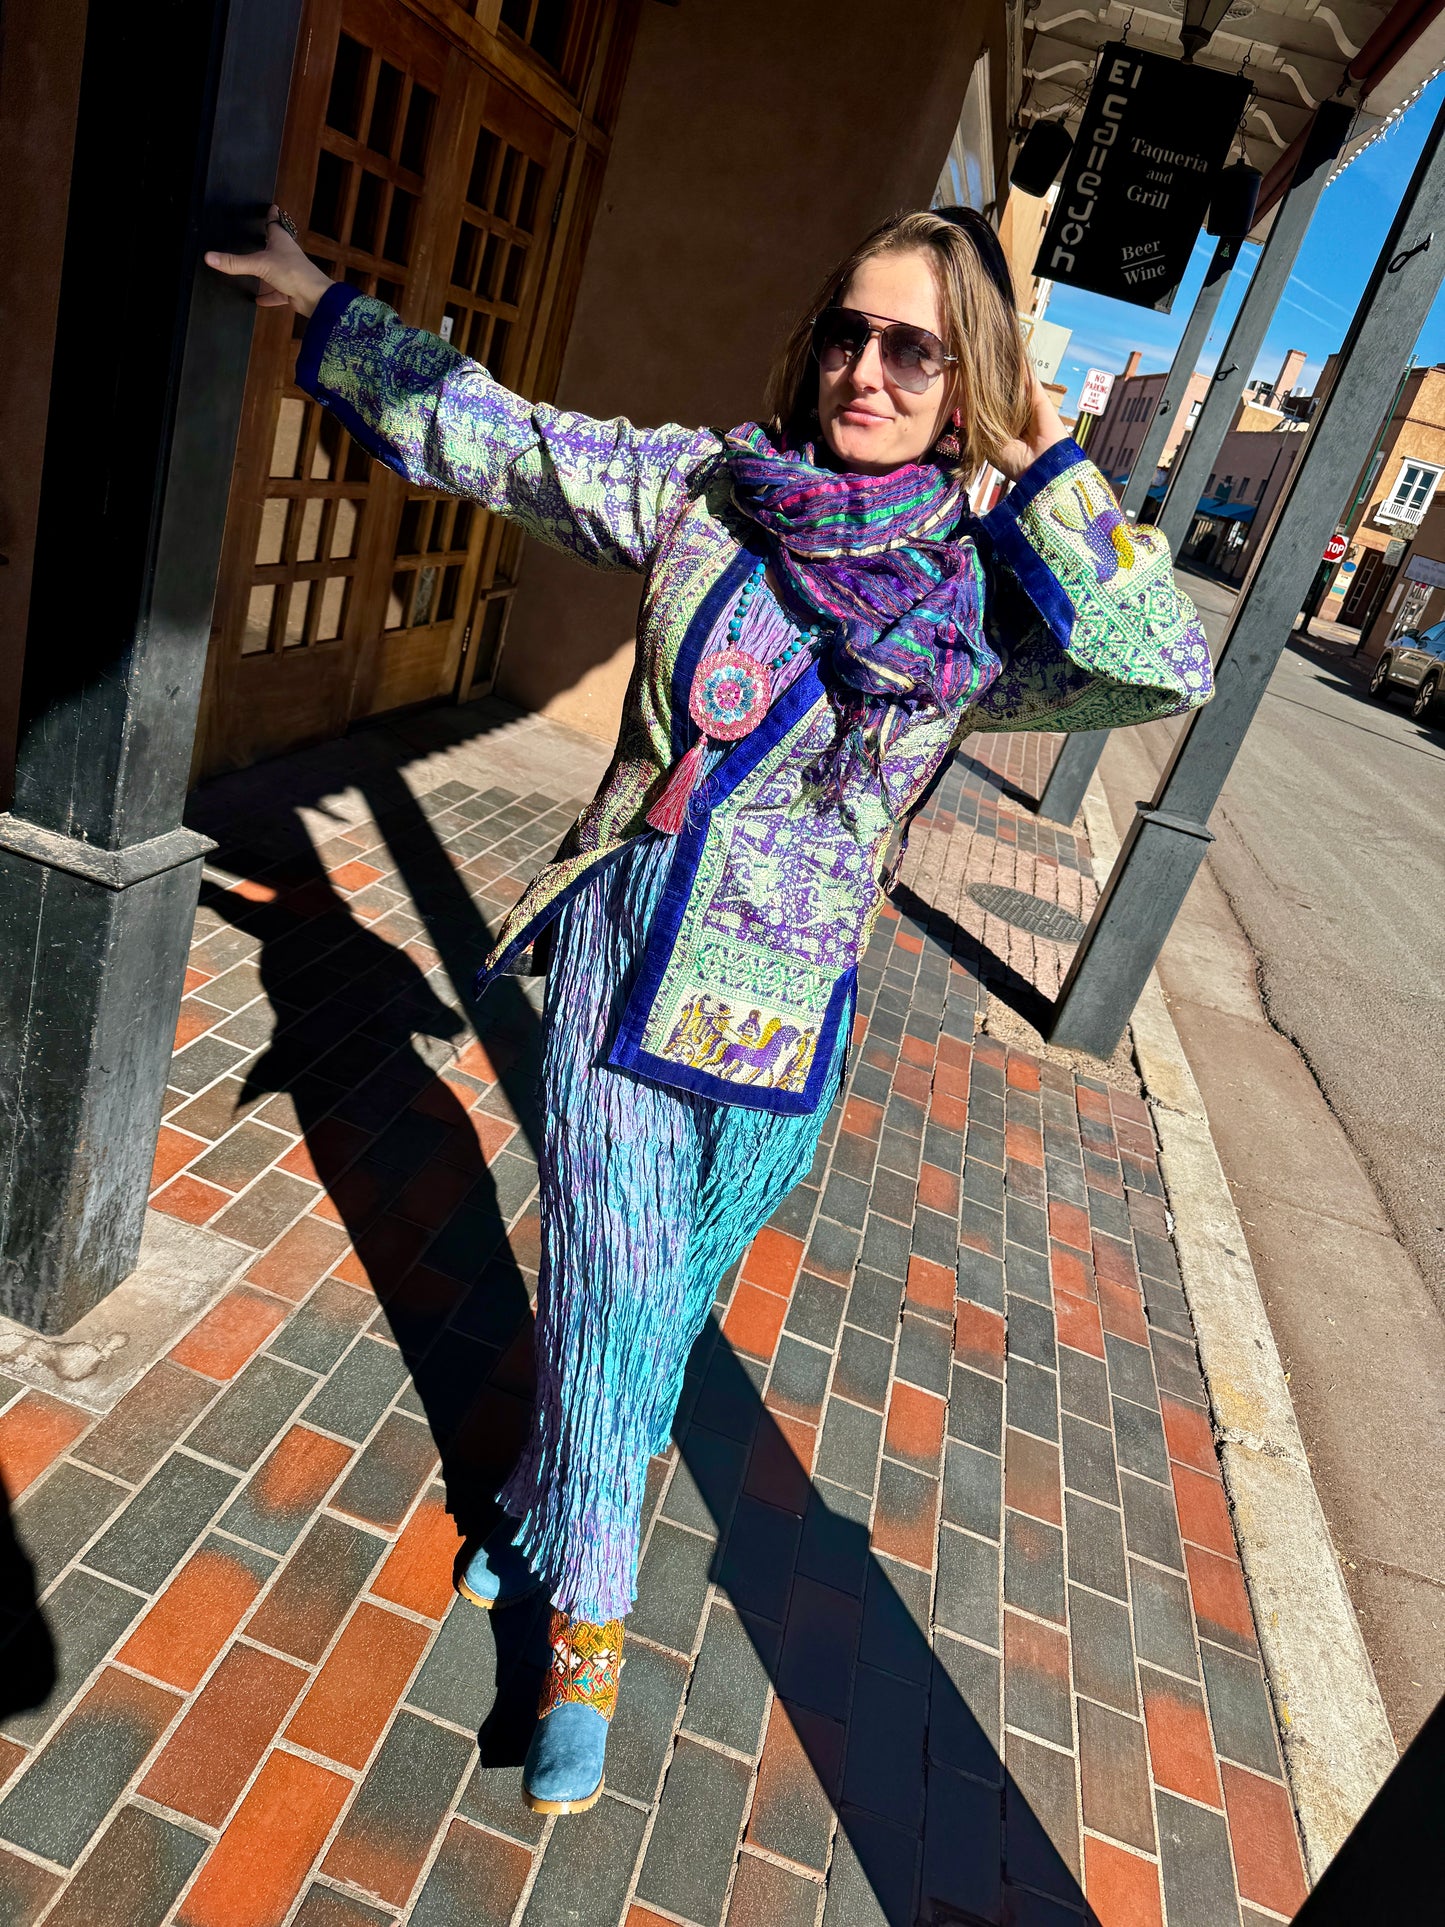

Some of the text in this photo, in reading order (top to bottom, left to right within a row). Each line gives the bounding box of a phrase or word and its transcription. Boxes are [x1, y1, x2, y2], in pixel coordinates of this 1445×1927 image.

[1108, 59, 1142, 88] El
[1131, 137, 1208, 172] Taqueria
[1146, 169, 1173, 184] and
[1127, 184, 1170, 209] Grill
[1121, 240, 1161, 261] Beer
[1124, 264, 1166, 285] Wine
[1095, 374, 1106, 383] NO
[1326, 541, 1345, 555] TOP
